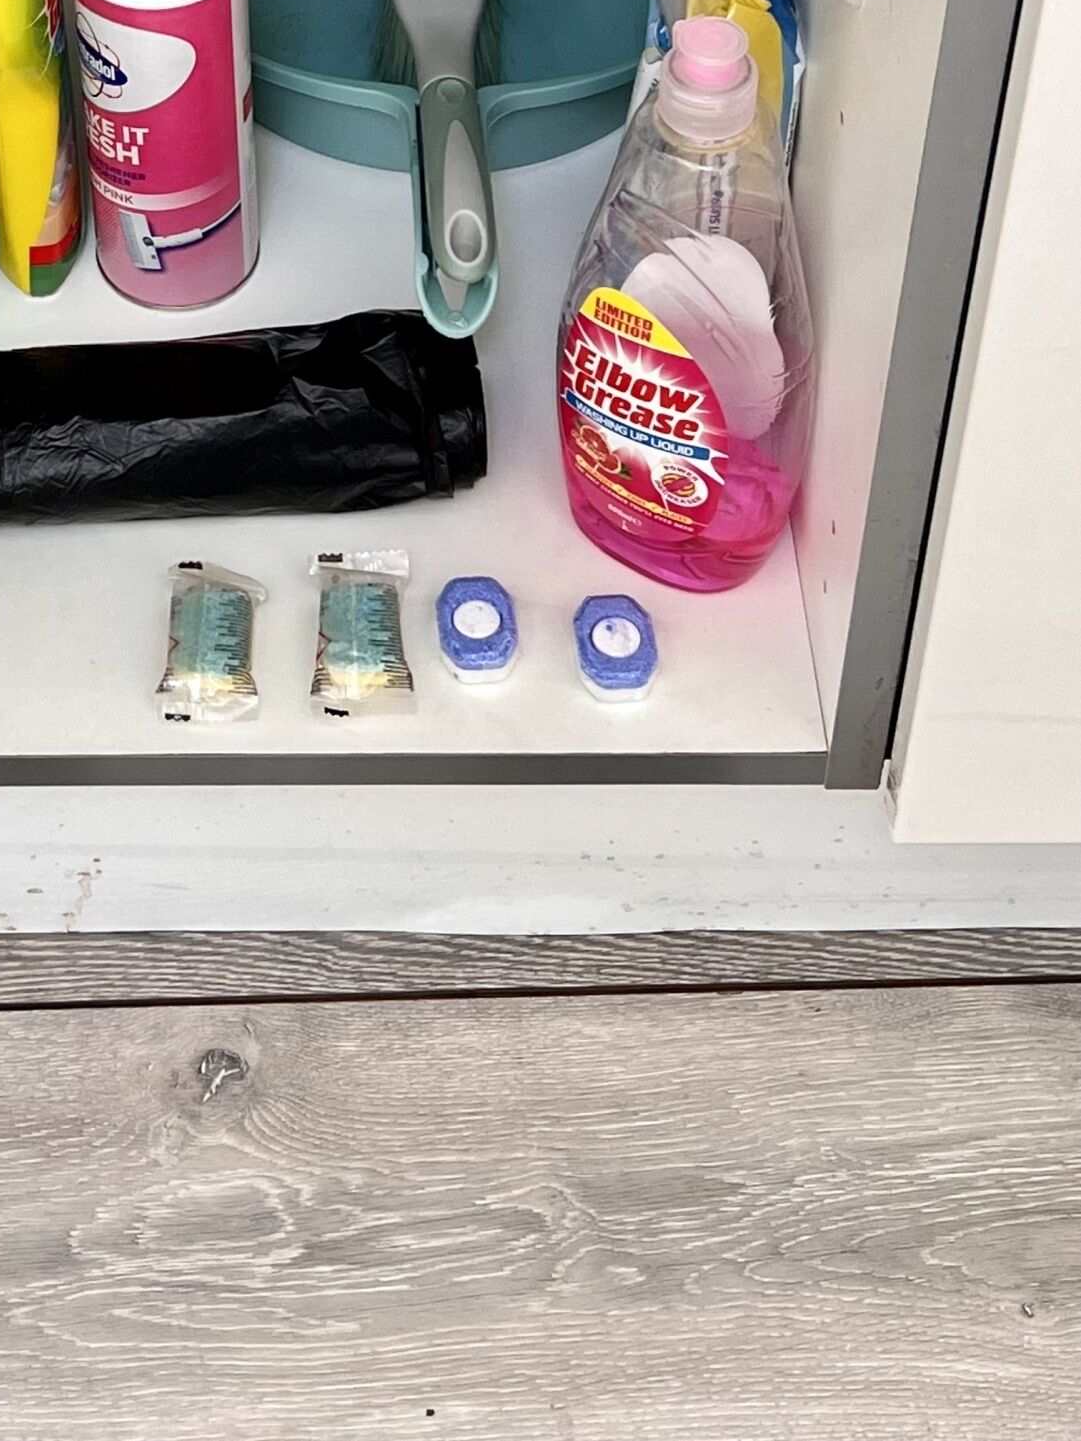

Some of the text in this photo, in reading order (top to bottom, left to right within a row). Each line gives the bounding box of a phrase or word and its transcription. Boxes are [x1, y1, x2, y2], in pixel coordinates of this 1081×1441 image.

[84, 101, 150, 146] AKE IT
[86, 124, 141, 166] ESH
[103, 184, 134, 205] PINK
[593, 308, 653, 343] EDITION
[595, 296, 654, 332] LIMITED
[574, 342, 701, 414] Elbow
[573, 370, 700, 442] Grease
[575, 398, 696, 458] WASHING UP LIQUID
